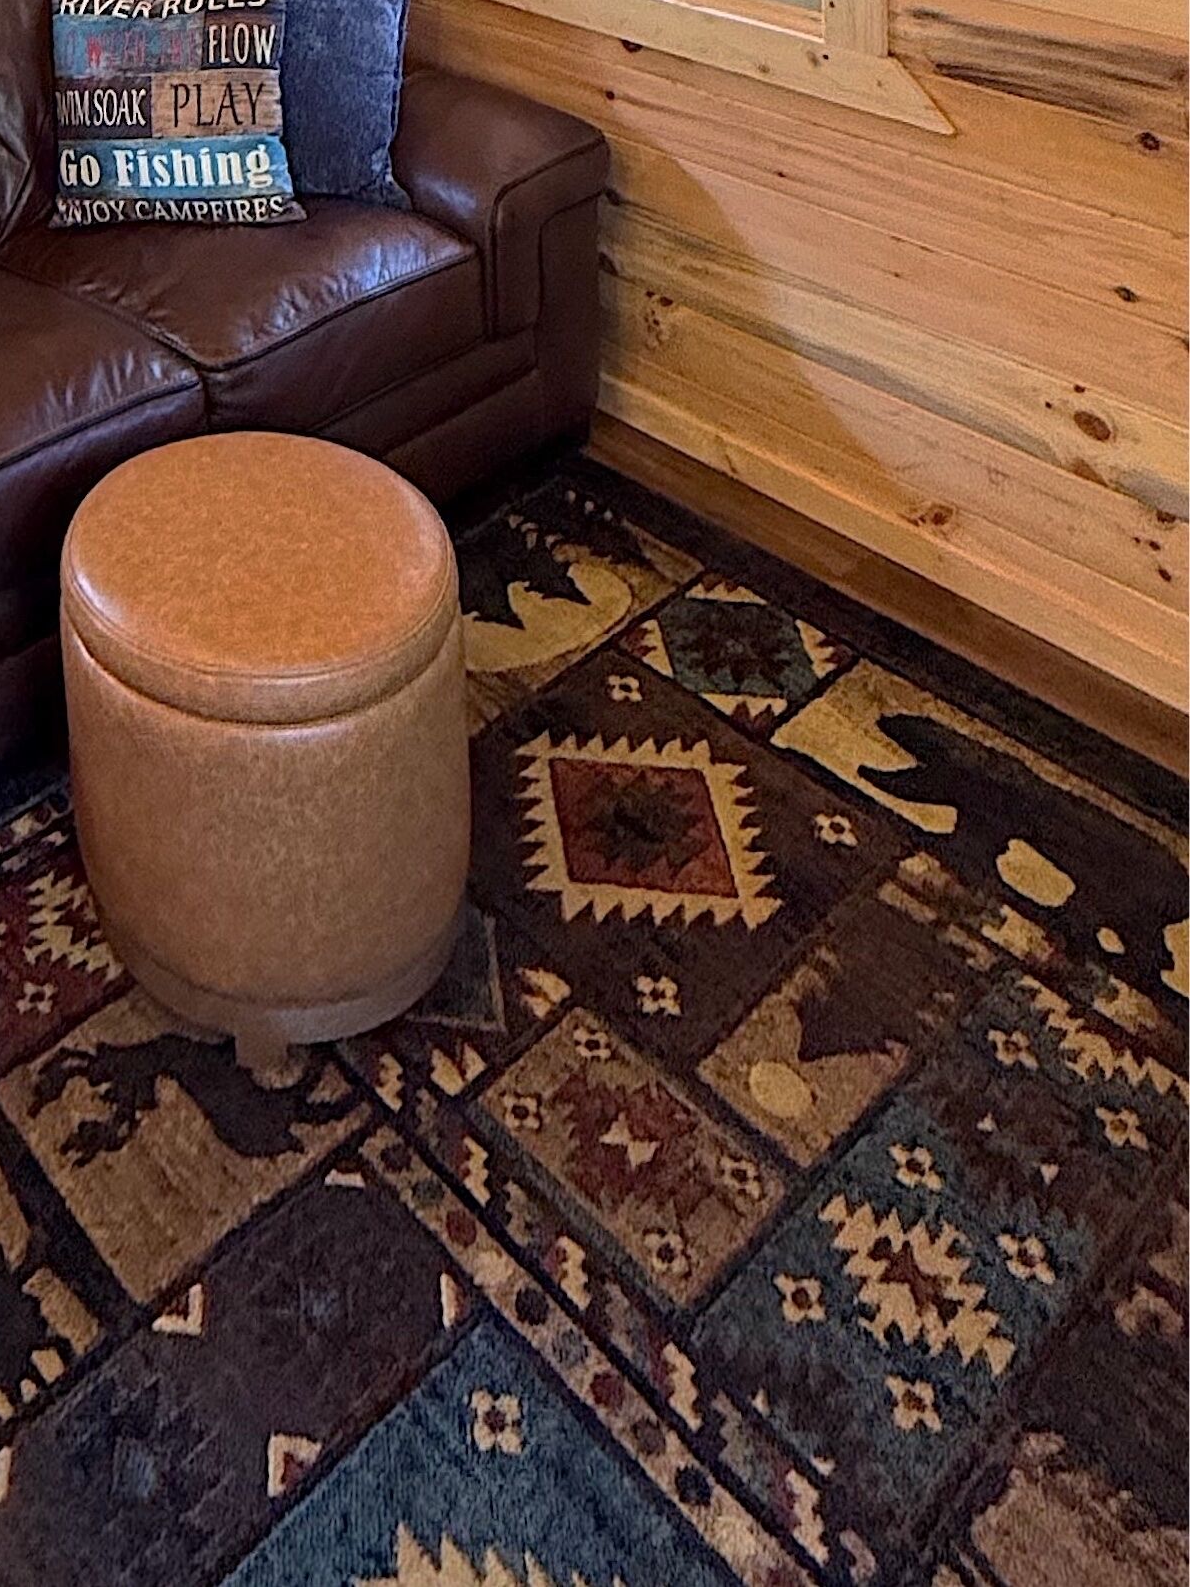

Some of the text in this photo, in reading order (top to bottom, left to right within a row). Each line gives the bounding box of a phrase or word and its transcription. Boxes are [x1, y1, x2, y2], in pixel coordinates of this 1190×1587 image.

[208, 23, 276, 65] FLOW
[93, 88, 147, 127] SOAK
[170, 82, 264, 128] PLAY
[113, 144, 274, 189] Fishing
[135, 196, 284, 223] CAMPFIRES
